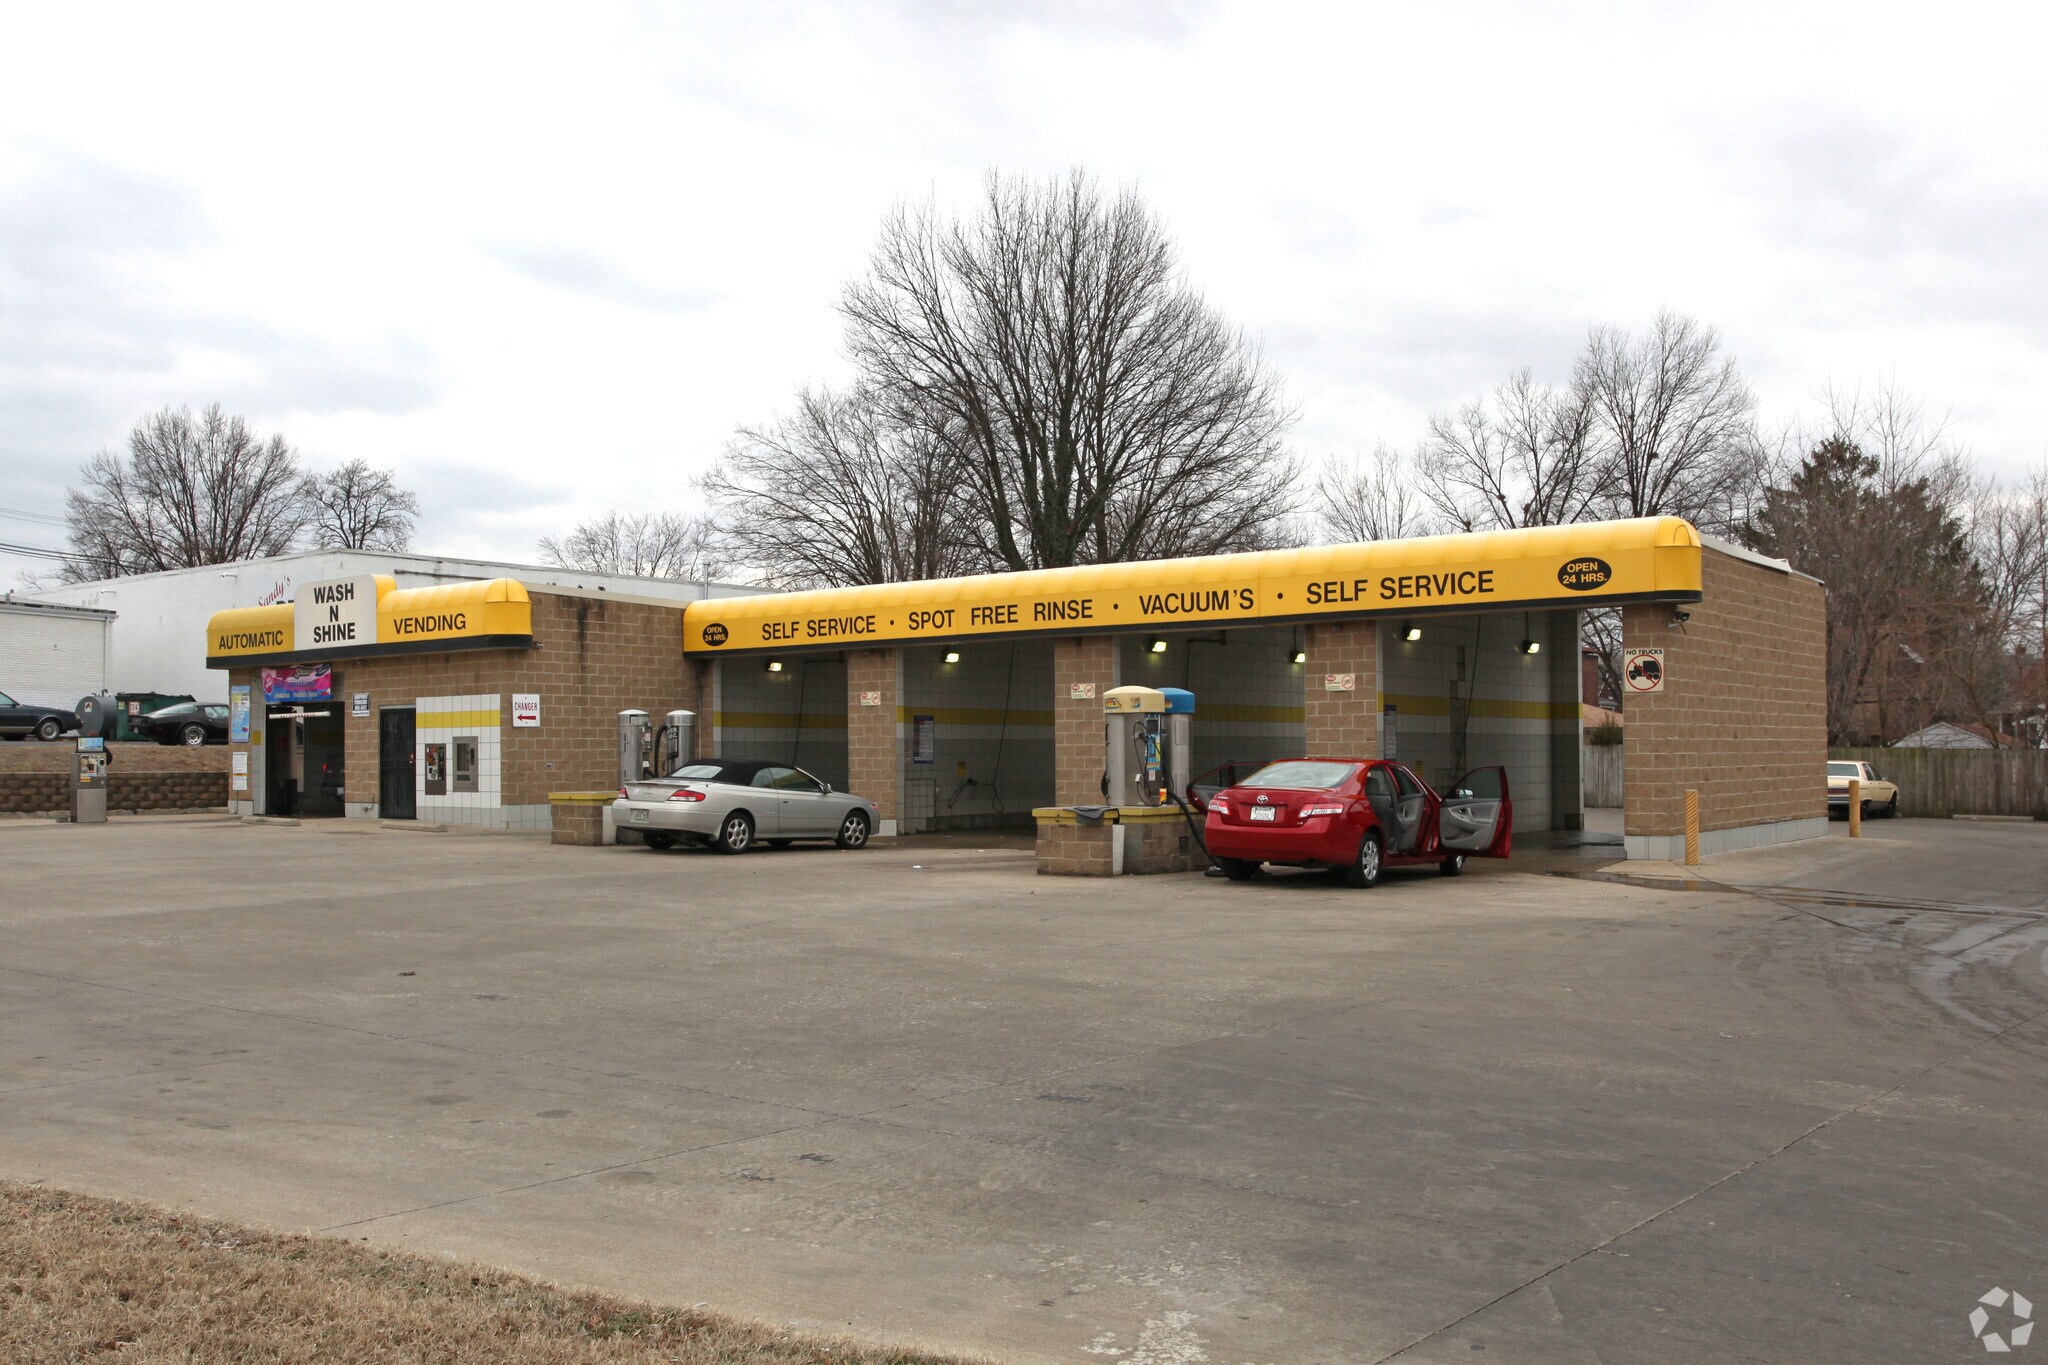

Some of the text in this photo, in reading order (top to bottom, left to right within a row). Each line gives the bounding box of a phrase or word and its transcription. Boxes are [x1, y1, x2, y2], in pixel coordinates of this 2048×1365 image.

[1566, 562, 1598, 573] OPEN
[1562, 572, 1608, 584] 24 HRS.
[258, 574, 291, 606] Sandy's
[313, 582, 355, 604] WASH
[329, 605, 339, 622] N
[762, 570, 1495, 641] SELF SERVICE SPOT FREE RINSE VACUUM'S SELF SERVICE
[313, 622, 356, 643] SHINE
[393, 613, 466, 635] VENDING
[706, 626, 723, 634] OPEN
[218, 630, 284, 650] AUTOMATIC
[514, 702, 538, 711] CHANGER
